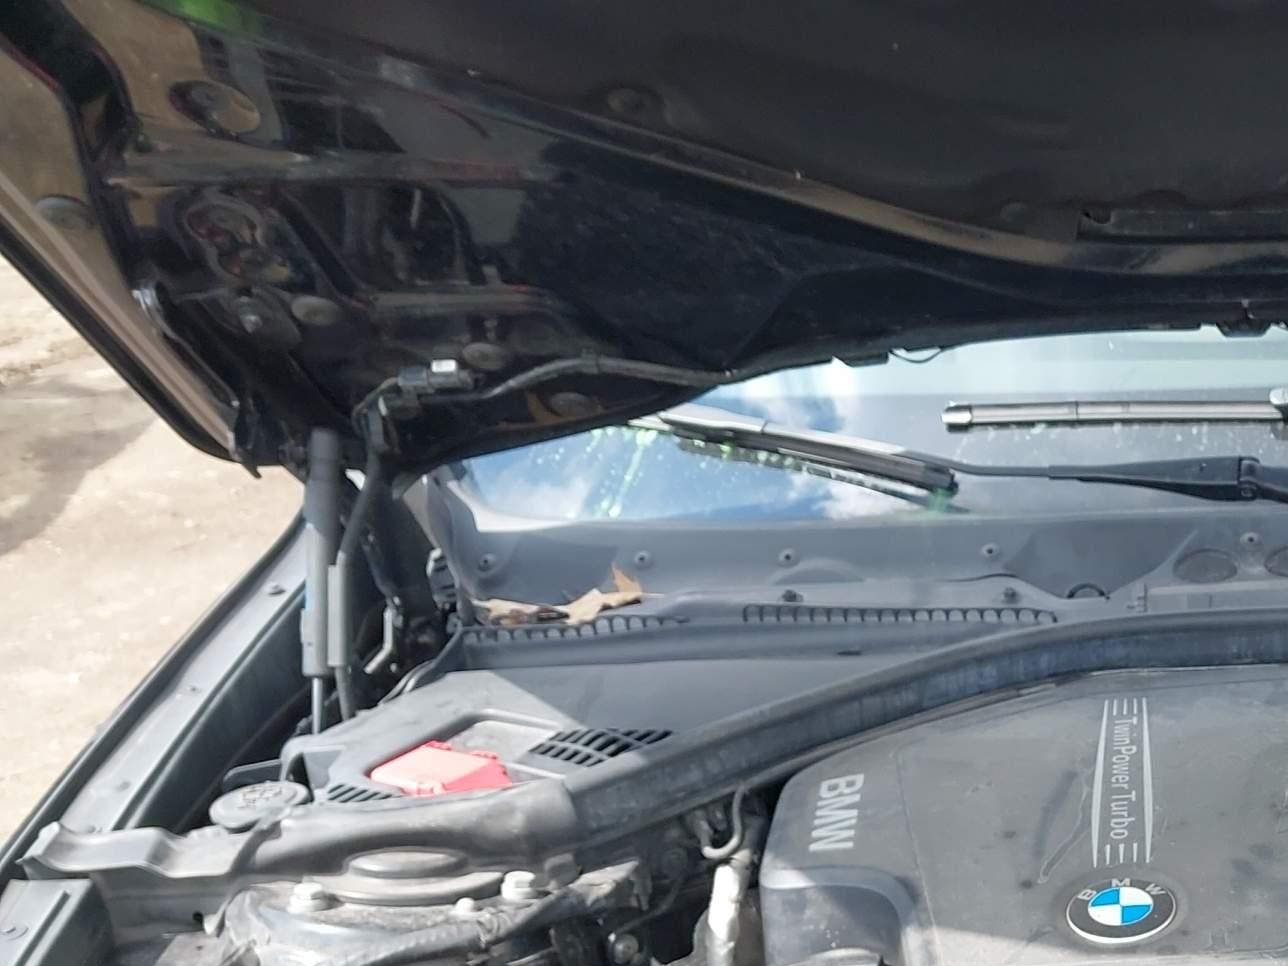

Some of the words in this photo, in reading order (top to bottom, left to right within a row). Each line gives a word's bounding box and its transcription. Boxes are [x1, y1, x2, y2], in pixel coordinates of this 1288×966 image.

[1111, 716, 1138, 790] TwinPower
[808, 773, 864, 851] BMW
[1109, 790, 1137, 840] Turbo
[1077, 877, 1167, 901] BMW
